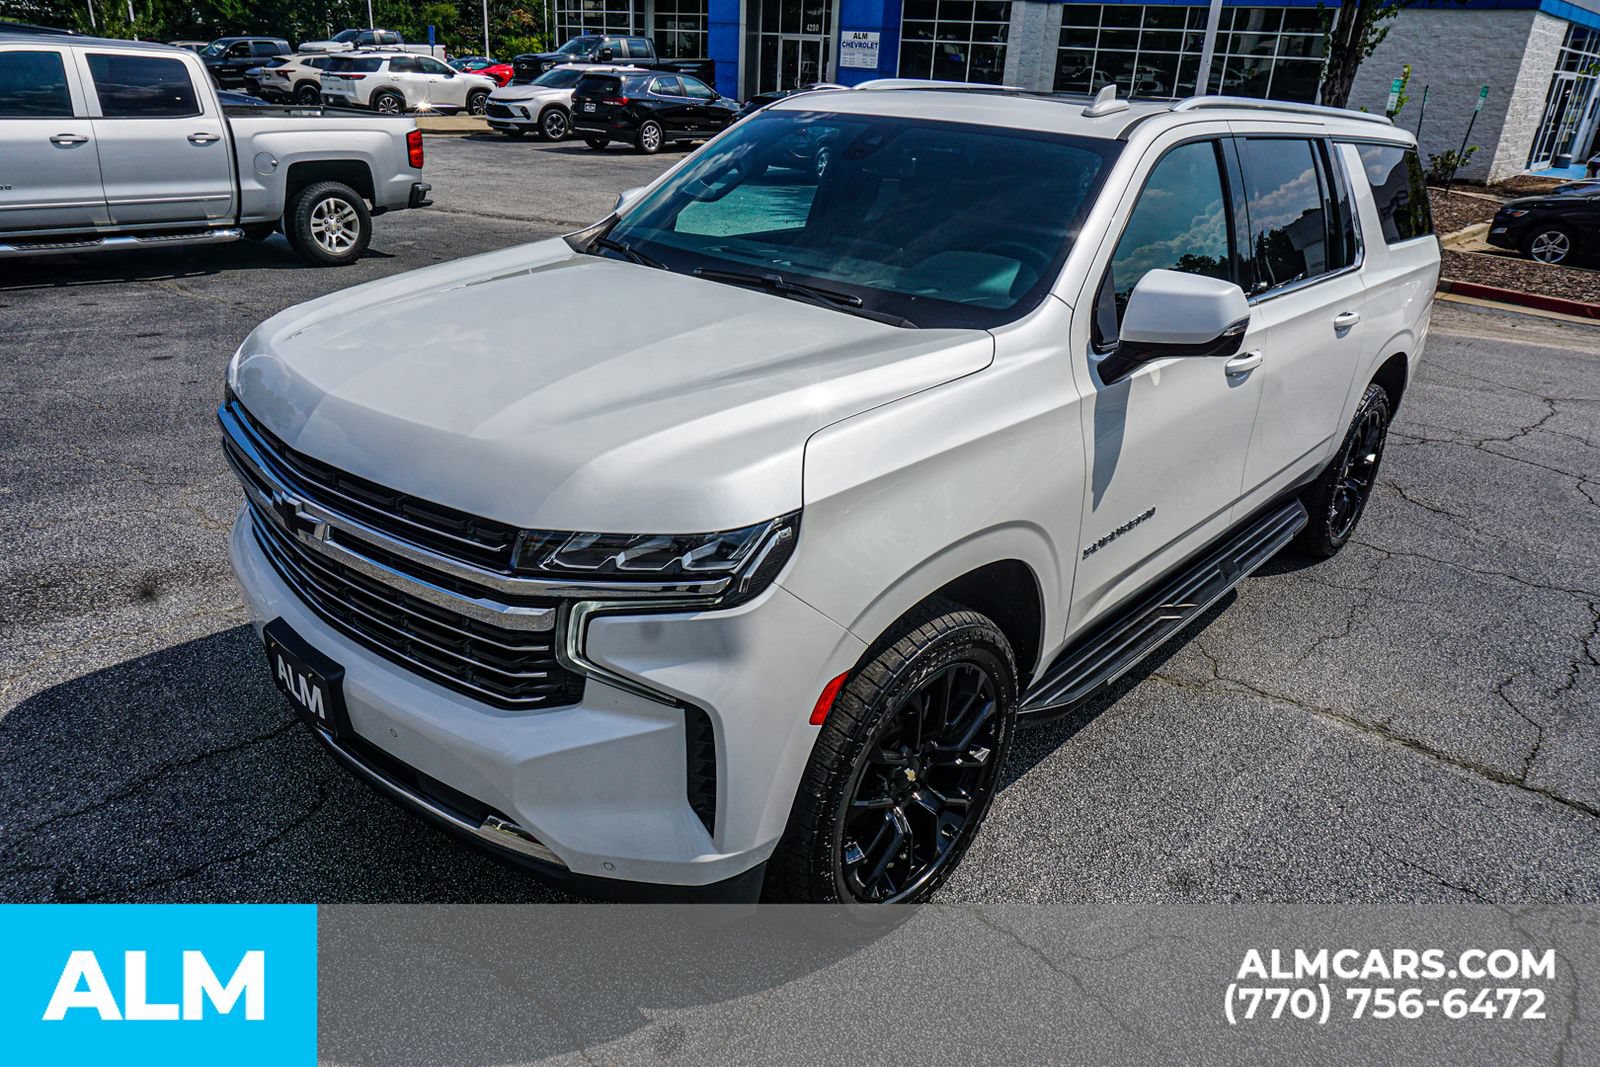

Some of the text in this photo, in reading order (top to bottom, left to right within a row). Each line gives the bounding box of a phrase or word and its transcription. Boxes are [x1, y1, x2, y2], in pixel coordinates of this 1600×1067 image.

[841, 41, 879, 49] CHEVROLET
[853, 32, 868, 40] ALM
[1082, 506, 1156, 560] SUBURBAN
[277, 654, 325, 720] ALM
